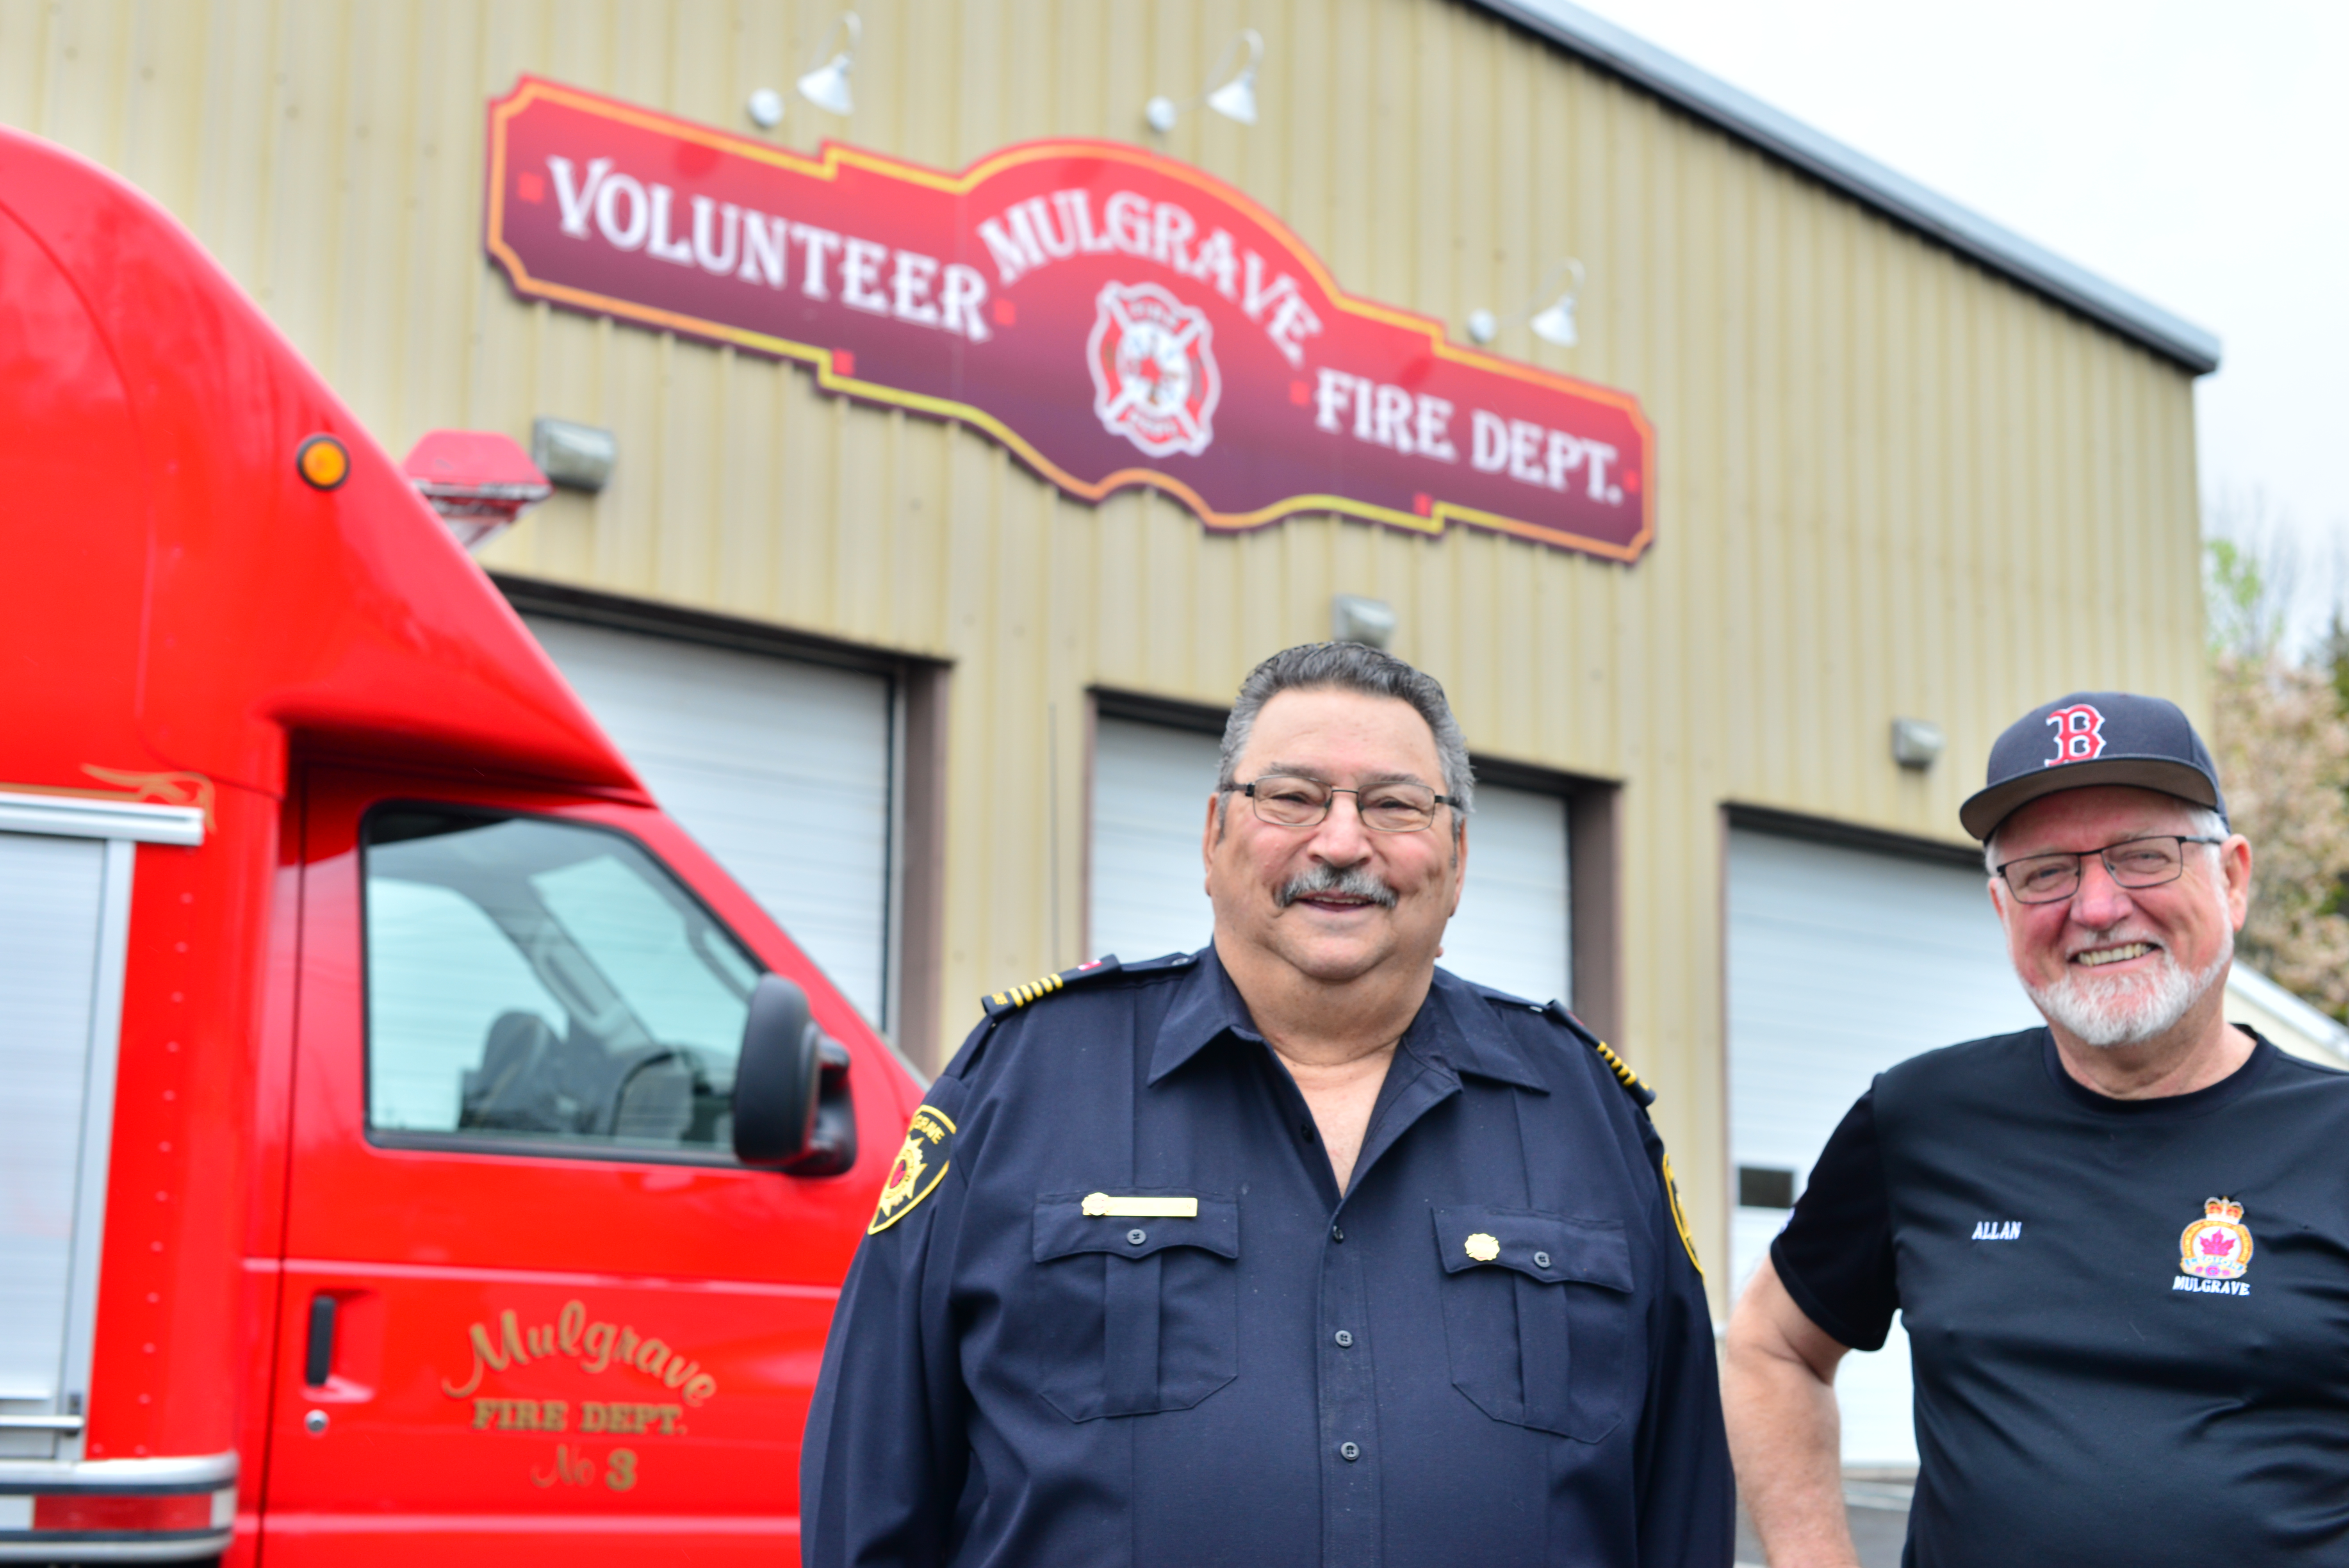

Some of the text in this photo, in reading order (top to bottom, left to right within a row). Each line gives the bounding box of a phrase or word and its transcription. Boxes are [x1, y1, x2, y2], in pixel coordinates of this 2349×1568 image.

[547, 156, 992, 342] VOLUNTEER
[978, 189, 1322, 369] MULGRAVE
[1315, 367, 1623, 506] FIRE DEPT.
[2044, 704, 2106, 767] B
[1971, 1221, 2022, 1240] ALLAN
[2173, 1276, 2250, 1296] MULGRAVE
[442, 1299, 716, 1406] Mulgrave
[472, 1398, 687, 1435] FIRE DEPT.
[606, 1447, 637, 1491] 3
